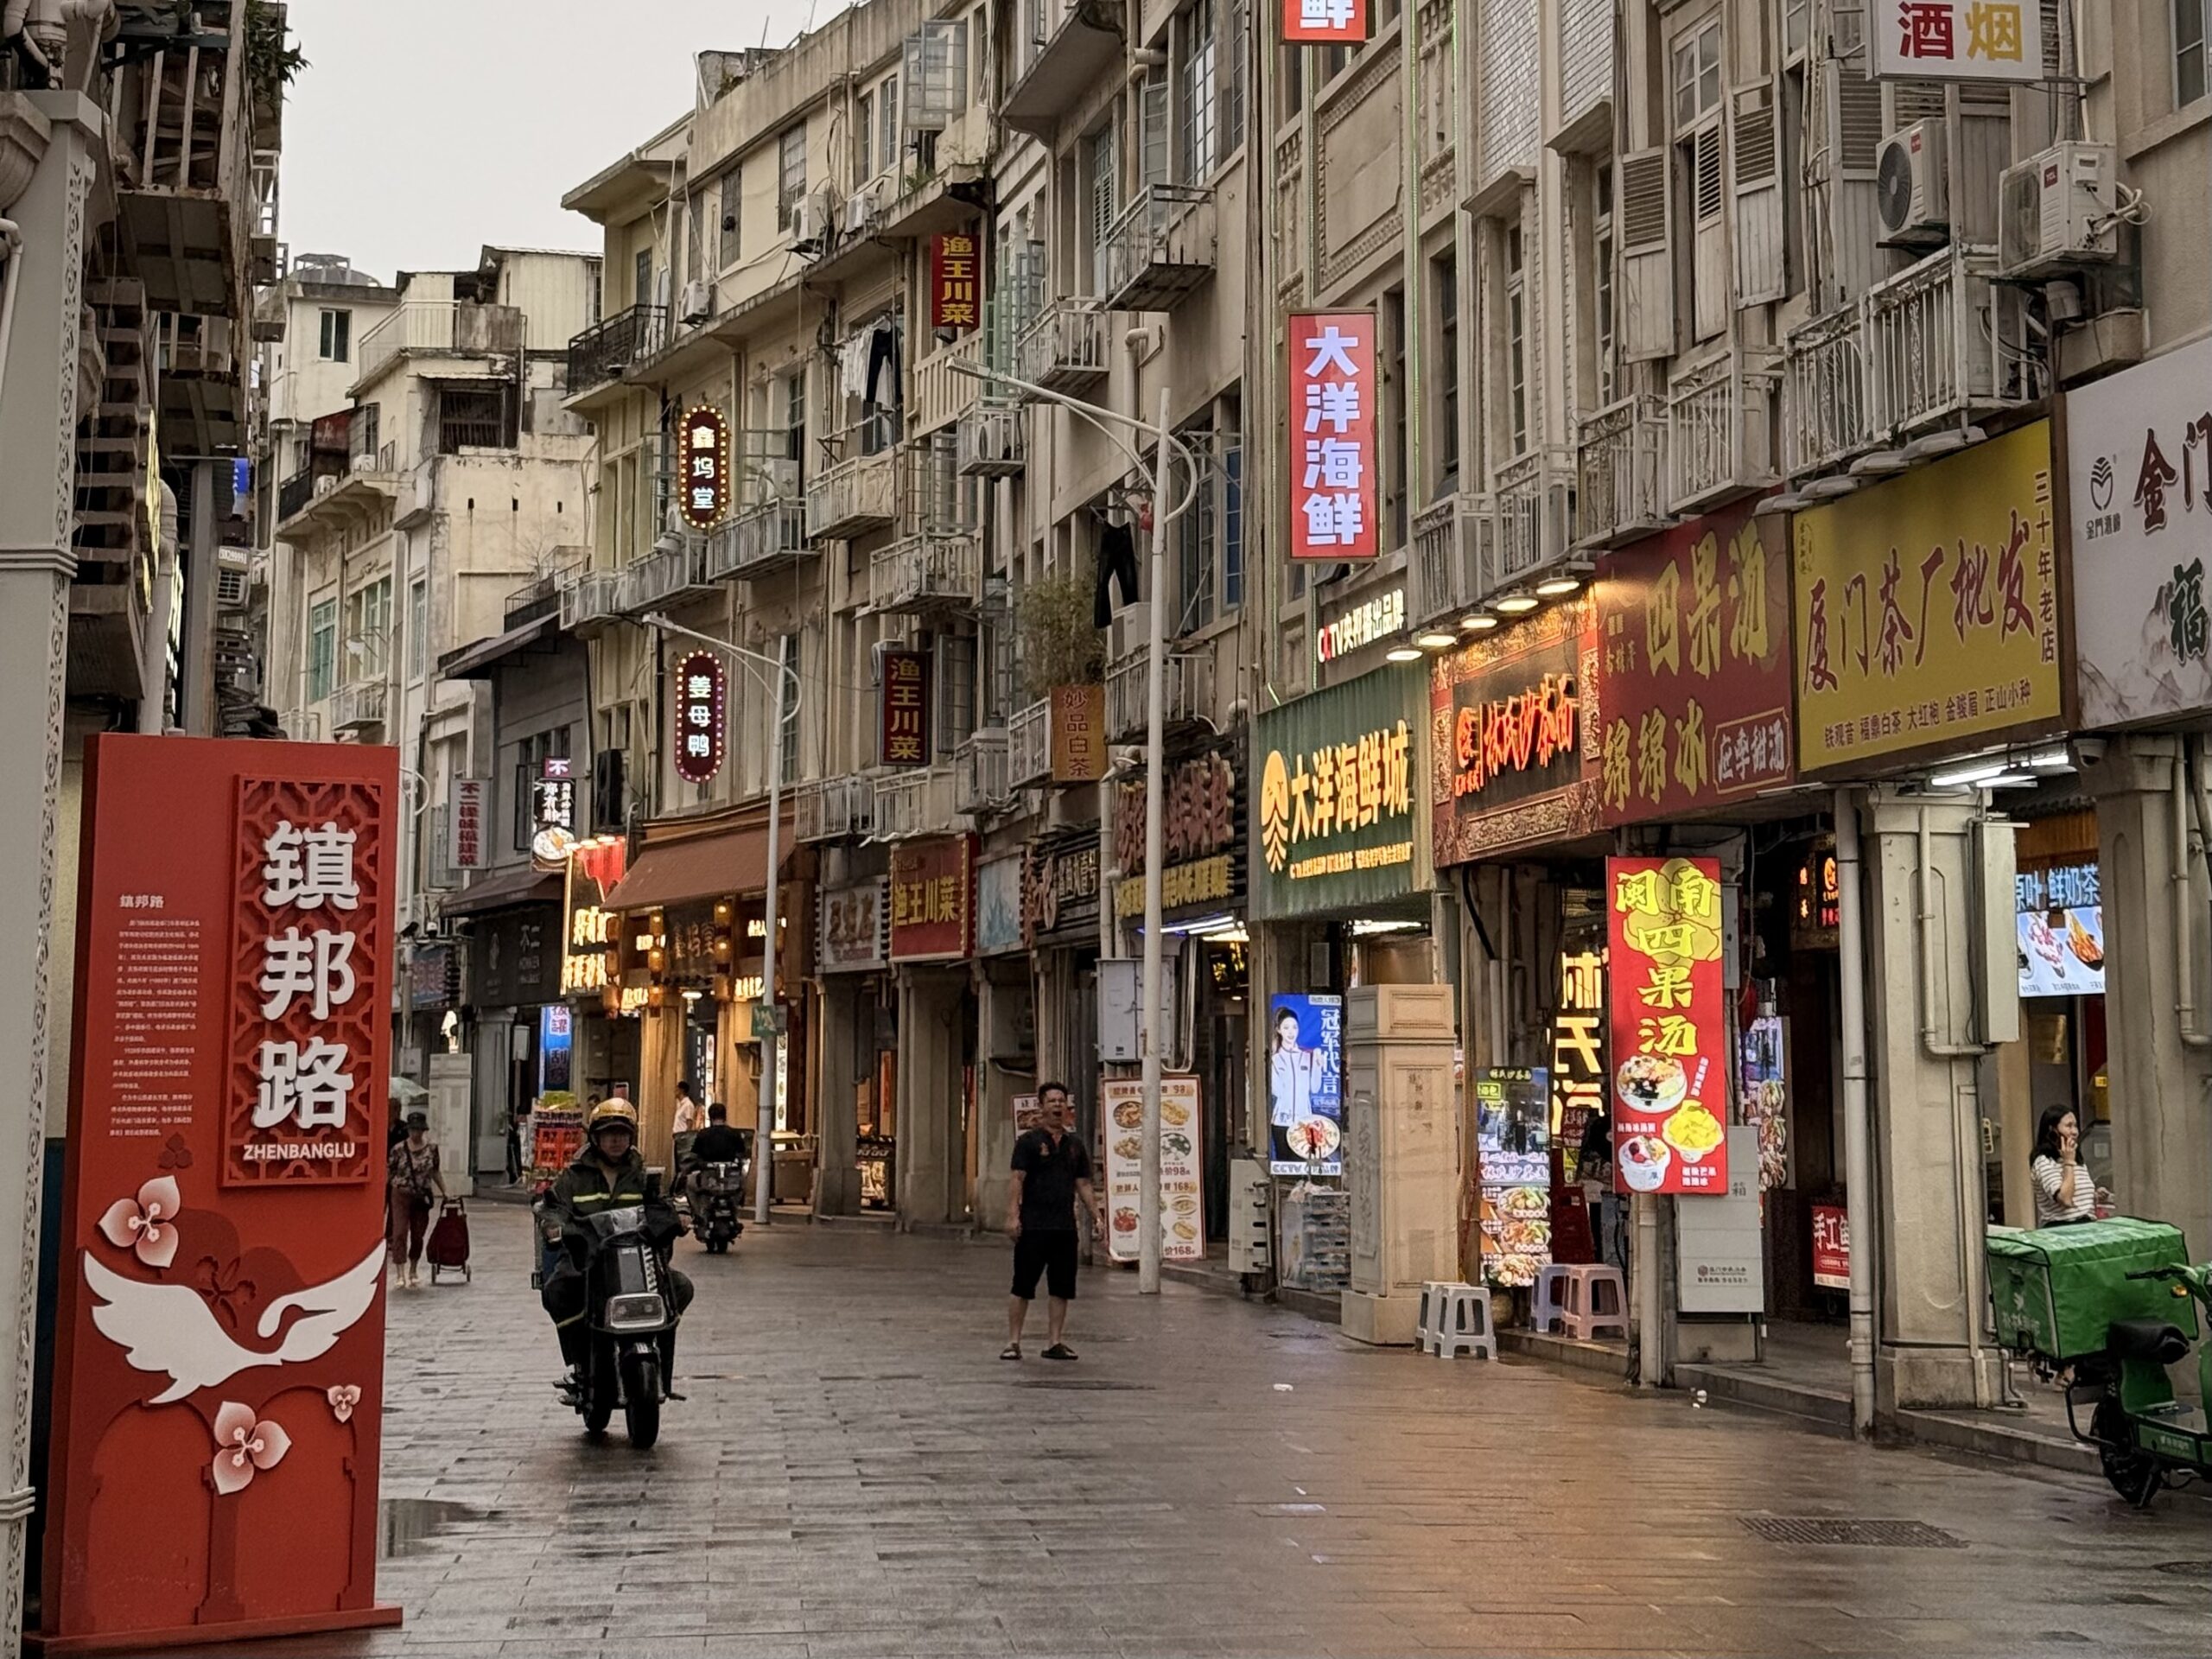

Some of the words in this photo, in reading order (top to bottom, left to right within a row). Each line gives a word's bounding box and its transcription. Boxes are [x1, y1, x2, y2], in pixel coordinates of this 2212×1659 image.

[941, 236, 974, 324] 渔王川菜
[1302, 326, 1363, 545] 大洋海鲜
[1645, 518, 1769, 680] 四果汤
[1803, 508, 2036, 699] 厦门茶厂批发
[2034, 472, 2056, 664] 三十年老店
[688, 675, 711, 758] 姜母鸭
[890, 658, 921, 760] 渔王川菜
[1906, 700, 1941, 731] 大红袍
[1984, 677, 2031, 714] 正山小种
[1291, 719, 1409, 844] 大洋海鲜城
[251, 819, 361, 1129] 镇邦路
[1637, 924, 1699, 1057] 四果汤
[1320, 1008, 1341, 1095] 冠军代言
[243, 1141, 356, 1162] ZHENBANGLU
